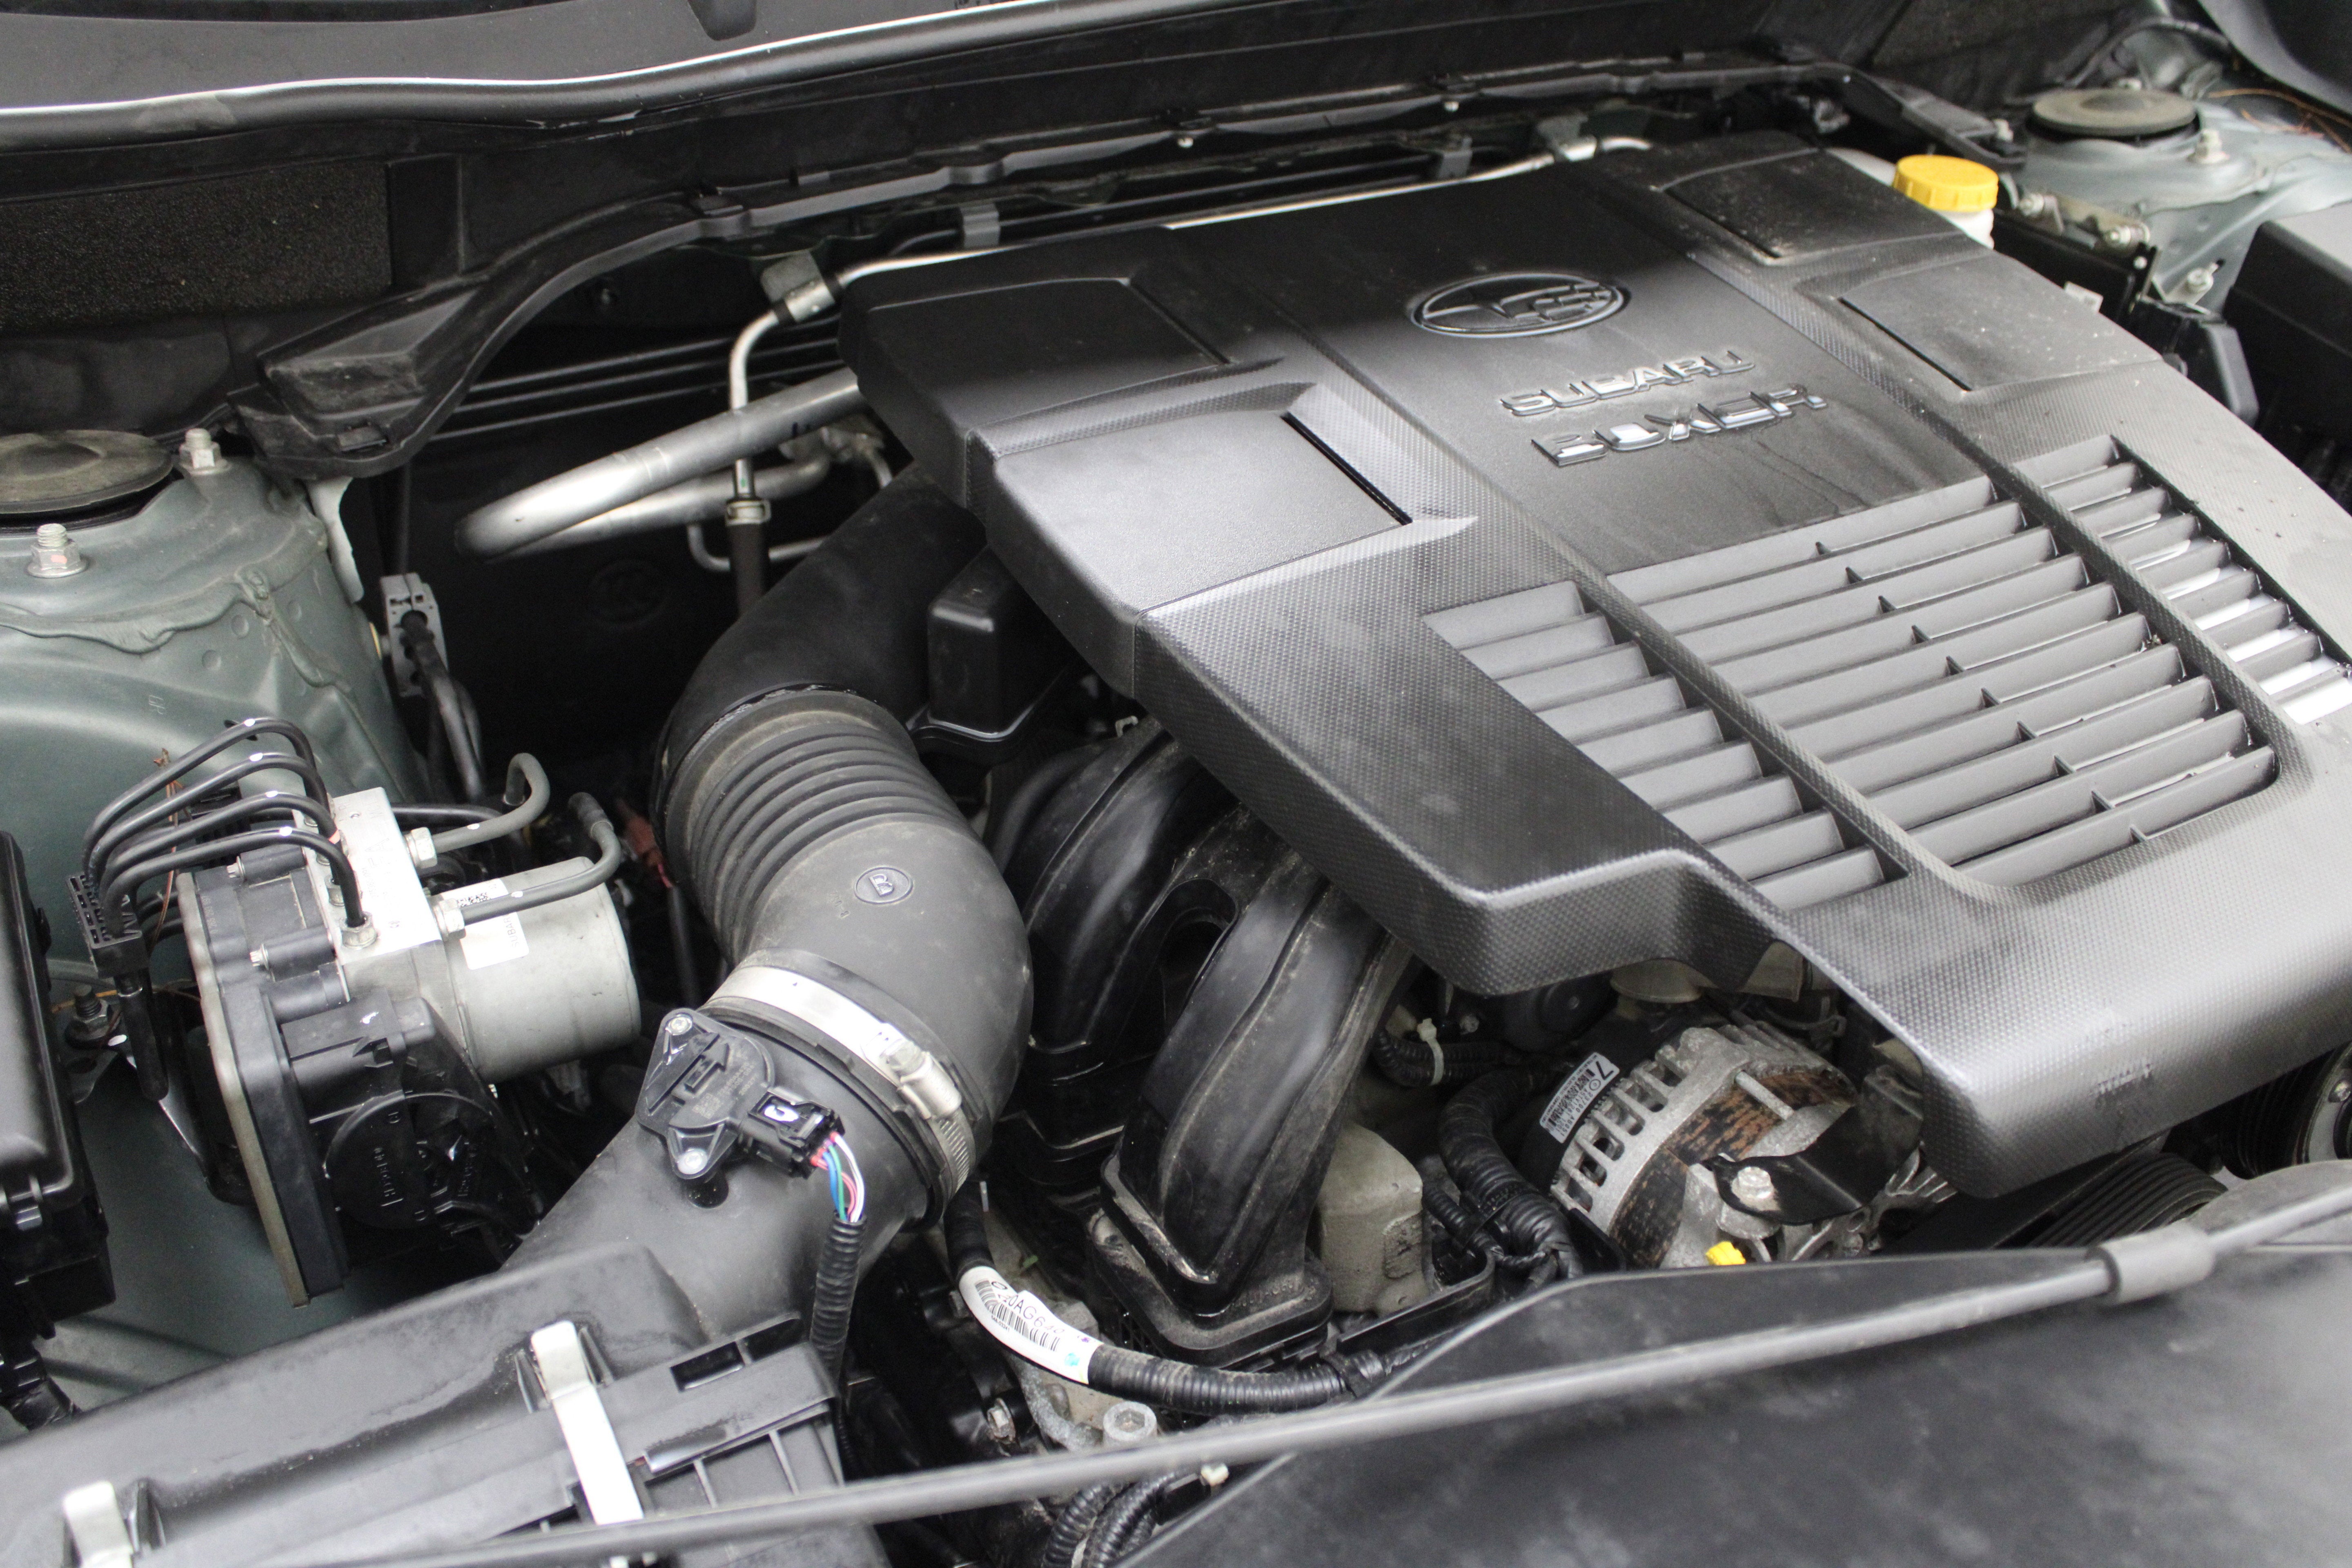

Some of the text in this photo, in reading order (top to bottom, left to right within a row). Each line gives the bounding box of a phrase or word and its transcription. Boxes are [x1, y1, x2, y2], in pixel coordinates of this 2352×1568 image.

[1501, 350, 1755, 416] SUBARU
[1531, 386, 1827, 467] BOXER
[869, 873, 895, 897] B
[503, 915, 519, 947] SUBAR
[1596, 1061, 1614, 1080] 7
